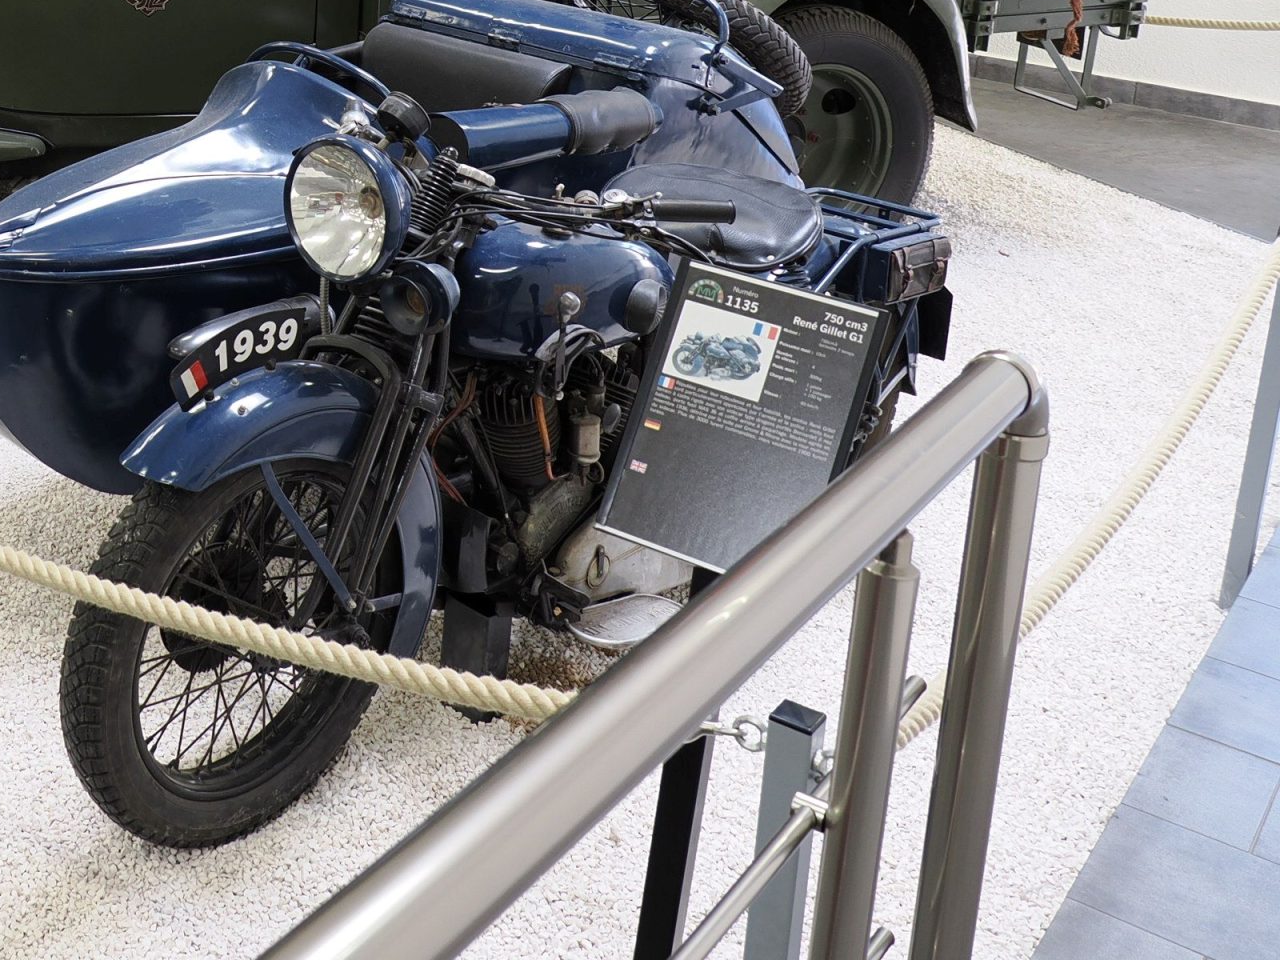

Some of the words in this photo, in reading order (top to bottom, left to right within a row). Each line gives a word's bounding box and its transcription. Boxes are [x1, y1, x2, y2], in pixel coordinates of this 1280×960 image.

[732, 285, 759, 298] Numéro
[724, 296, 760, 314] 1135
[792, 315, 818, 330] René
[819, 323, 848, 339] Gillet
[849, 332, 864, 344] G1
[823, 311, 844, 325] 750
[845, 319, 868, 332] cm3
[214, 317, 298, 372] 1939
